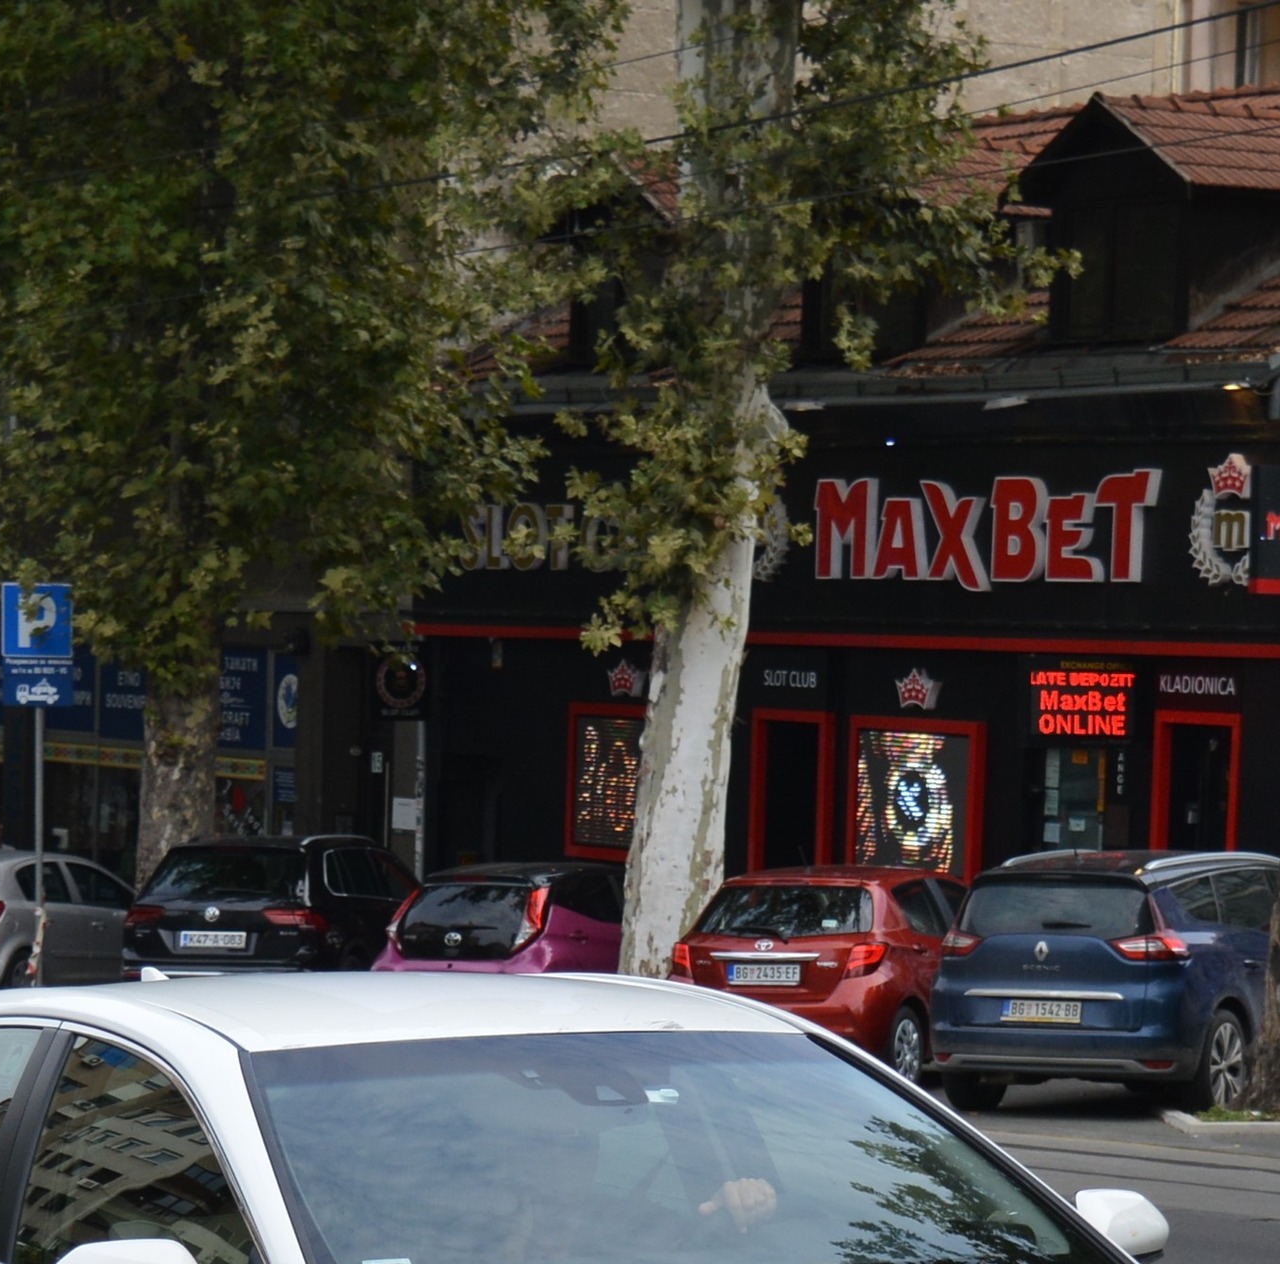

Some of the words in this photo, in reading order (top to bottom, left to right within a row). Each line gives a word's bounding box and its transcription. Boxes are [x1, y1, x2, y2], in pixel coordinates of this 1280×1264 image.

[460, 502, 574, 571] SLOT
[814, 468, 1162, 592] MAXBET
[18, 593, 57, 648] P
[764, 670, 788, 686] SLOT
[789, 671, 817, 688] CLUB
[1159, 674, 1236, 696] KLADIONICA
[1039, 690, 1126, 712] MaxBet
[1038, 713, 1126, 736] ONLINE
[735, 966, 748, 979] BG
[1011, 1002, 1025, 1015] BG
